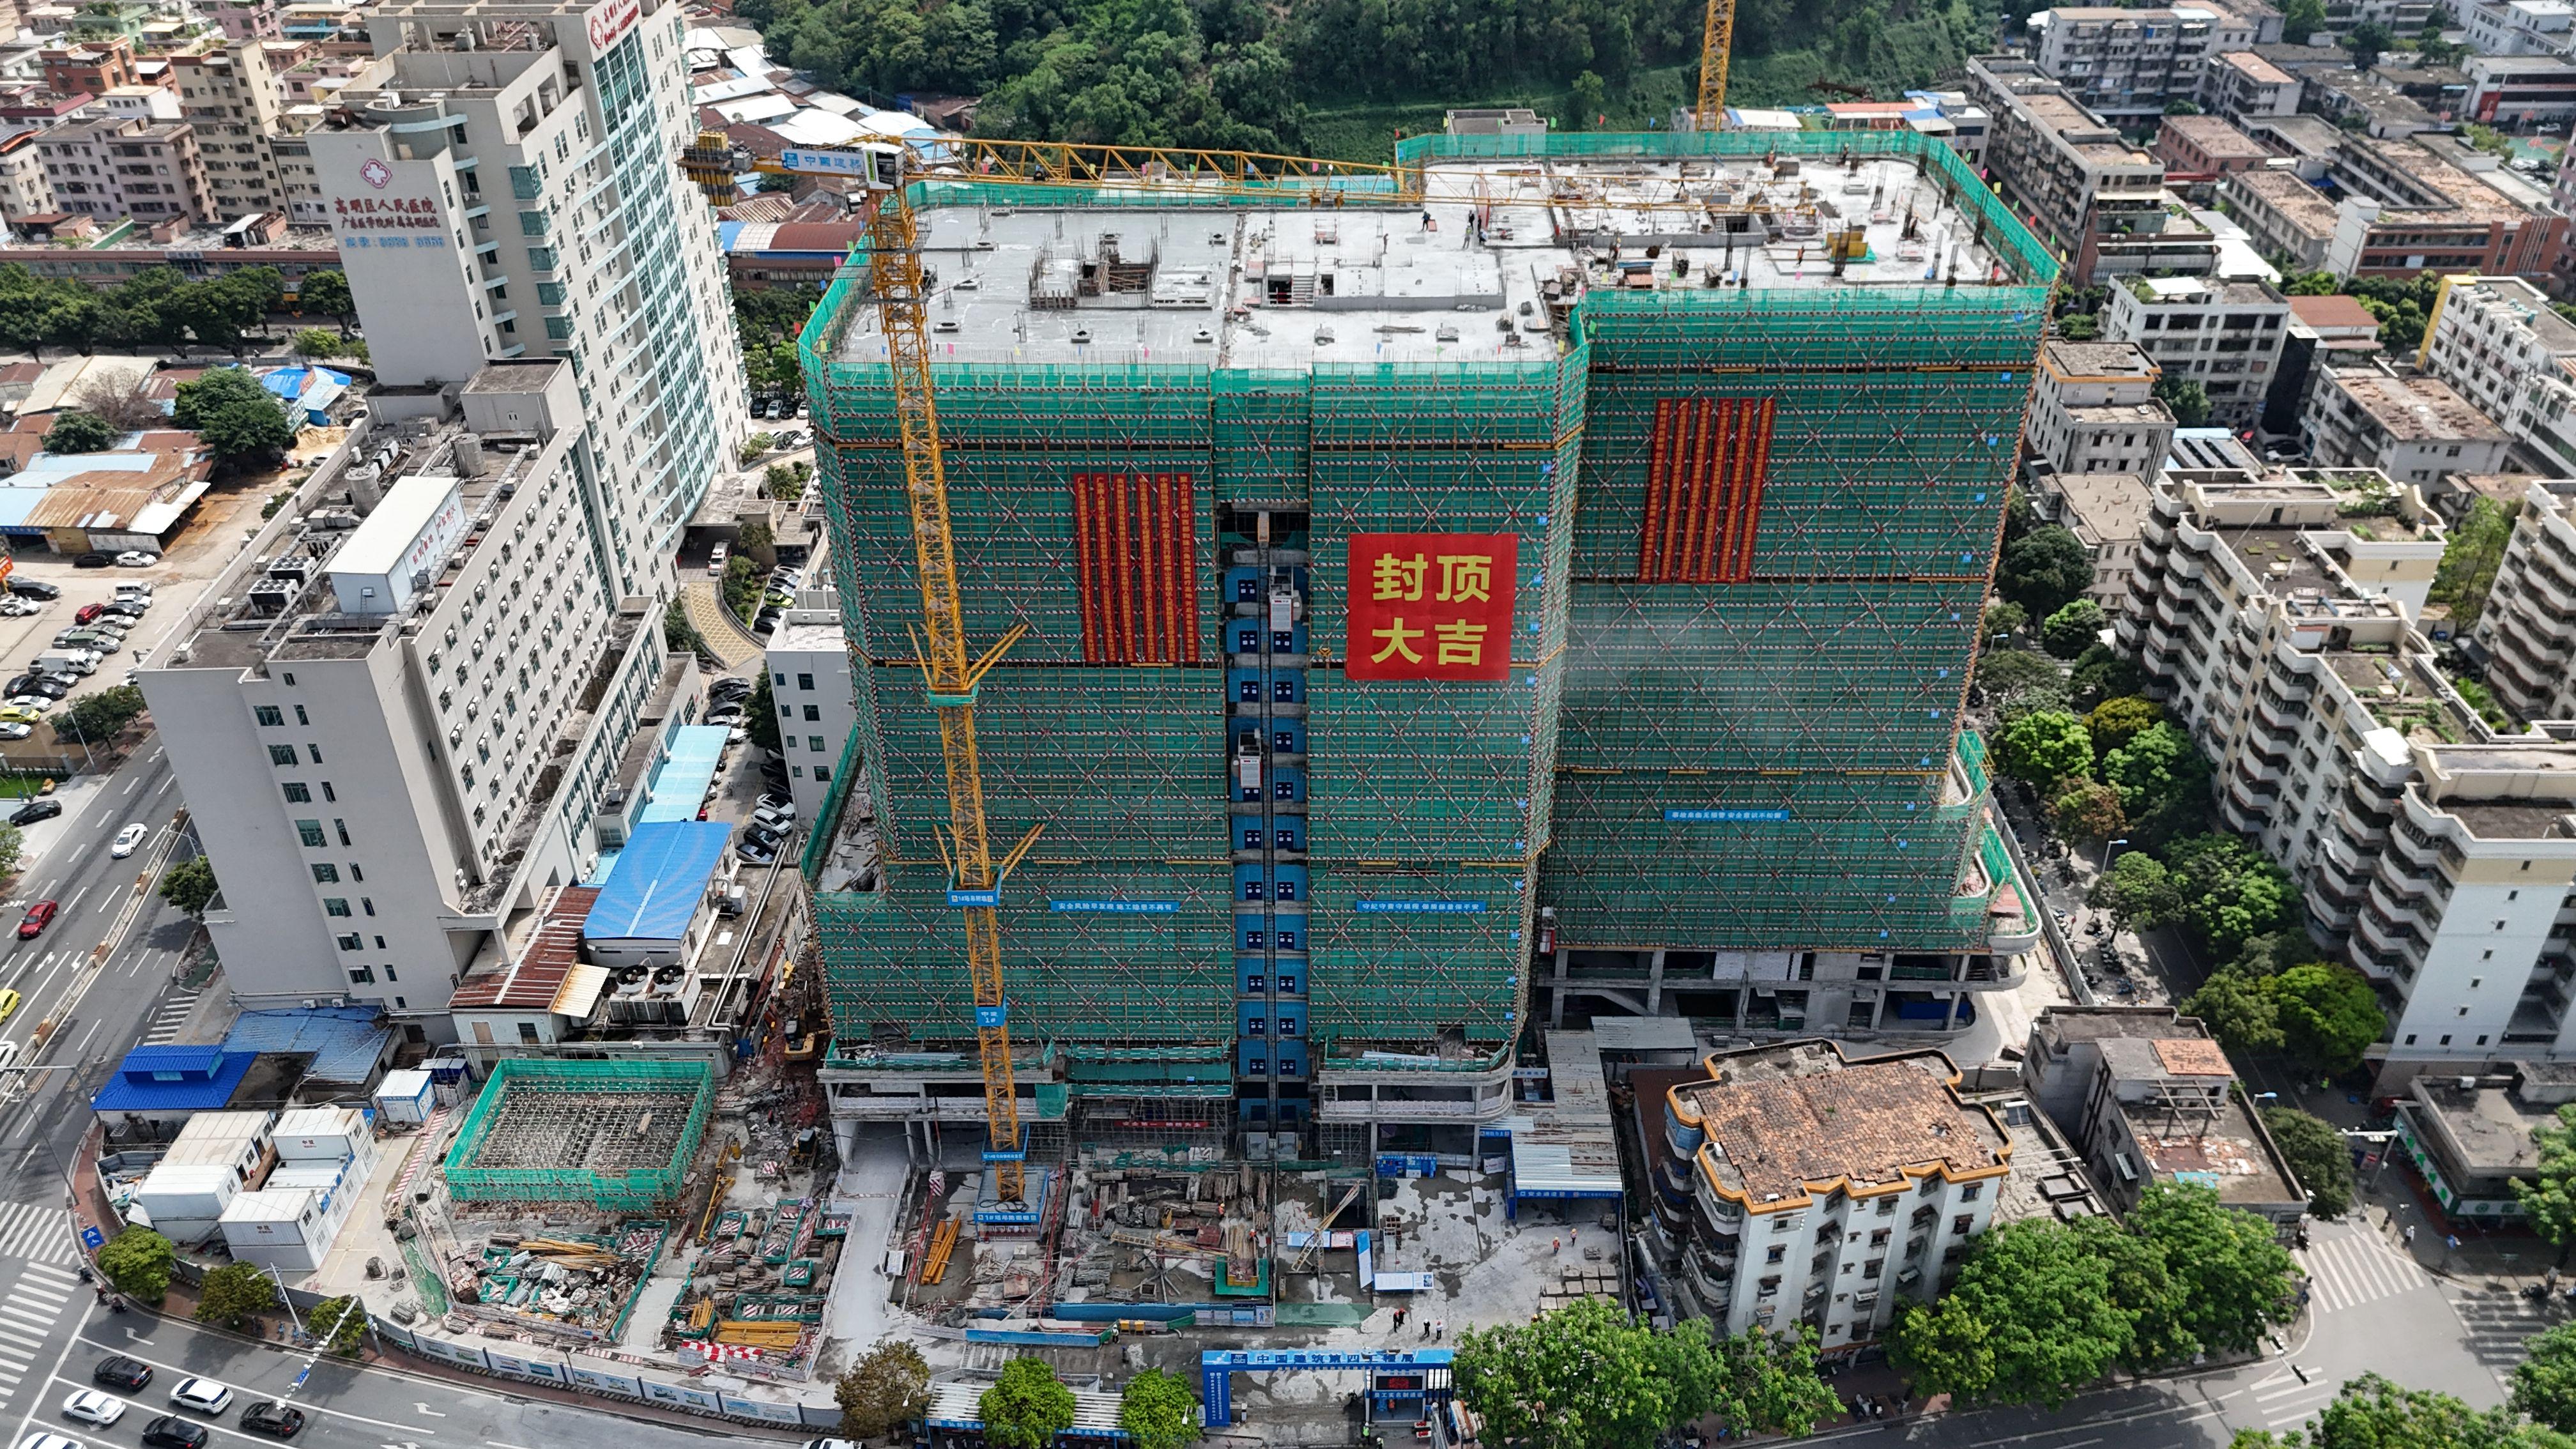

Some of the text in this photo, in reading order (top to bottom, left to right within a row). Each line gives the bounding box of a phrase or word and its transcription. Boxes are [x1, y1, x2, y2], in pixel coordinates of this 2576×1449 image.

[334, 197, 437, 215] 高明区人民医院
[1373, 553, 1492, 602] 封顶
[1370, 617, 1487, 665] 大吉
[1257, 1353, 1414, 1364] 中国建筑第四工程局
